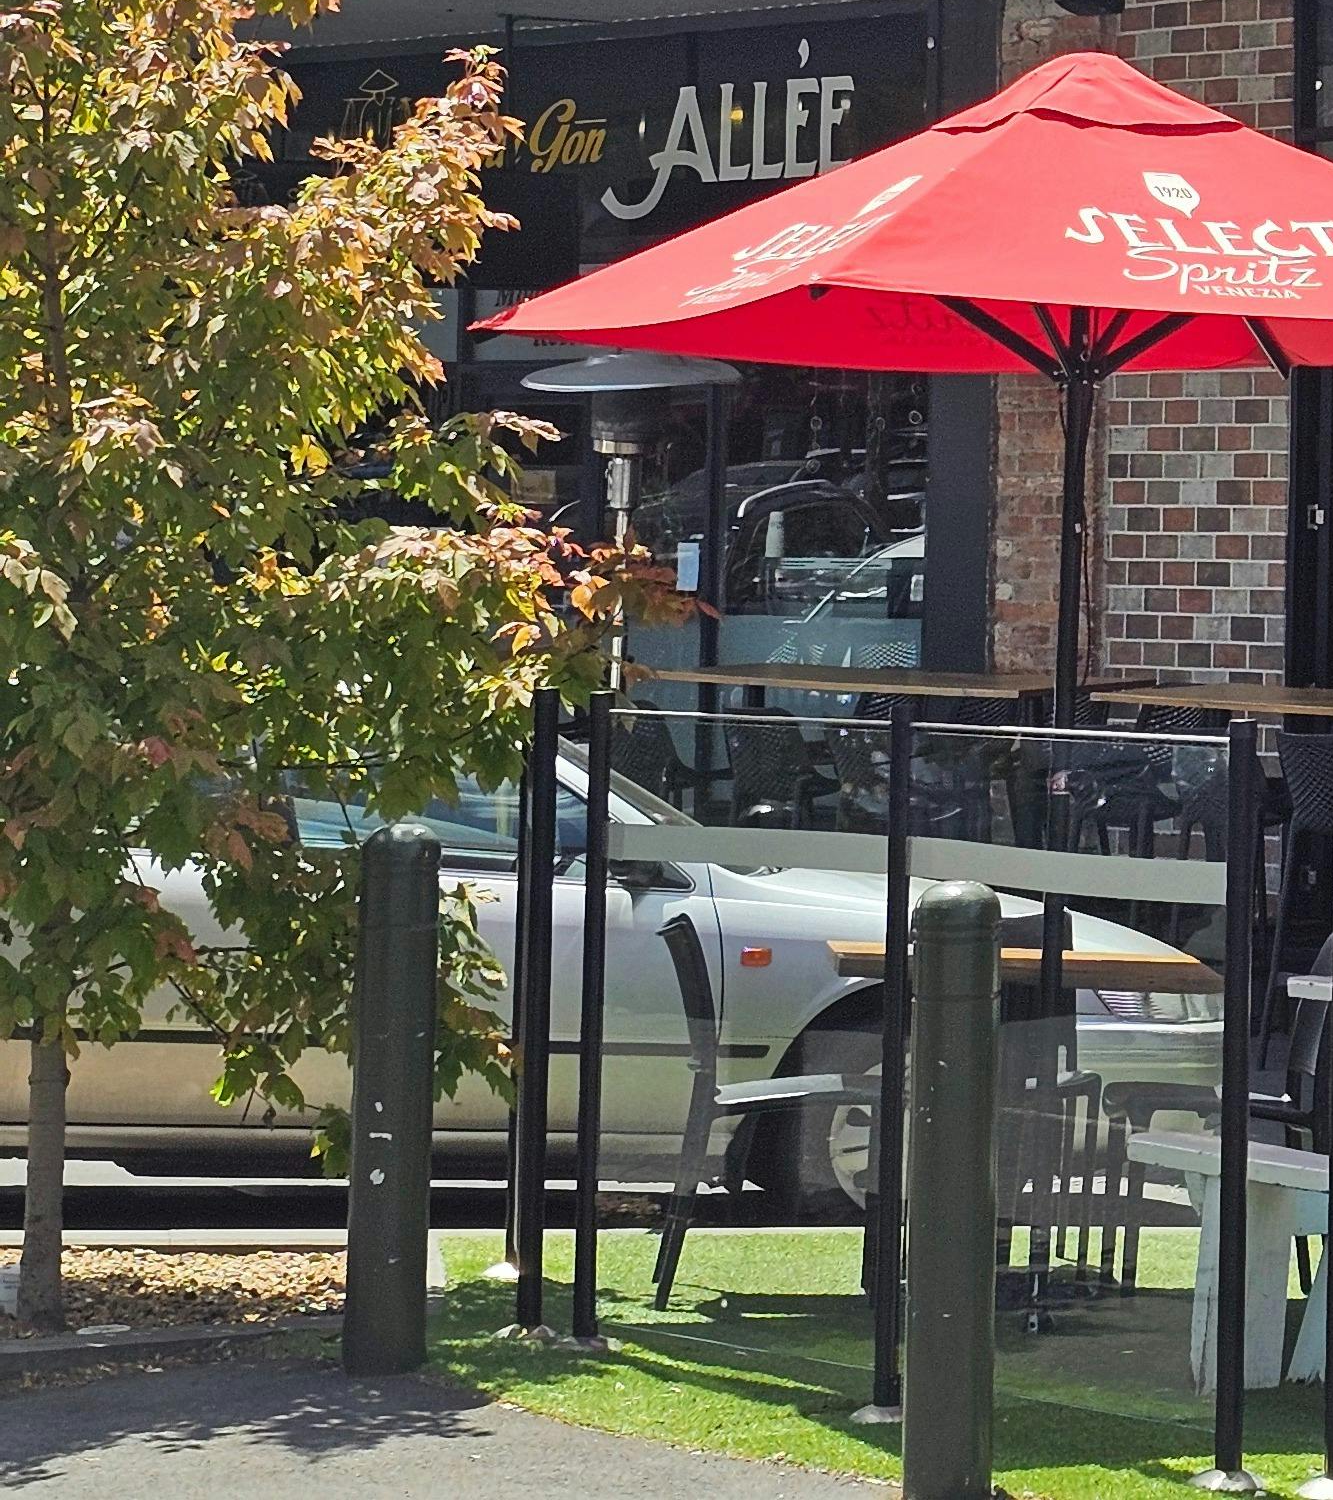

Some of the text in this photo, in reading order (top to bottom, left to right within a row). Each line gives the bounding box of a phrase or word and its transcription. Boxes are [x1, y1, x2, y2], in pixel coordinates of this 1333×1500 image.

[1153, 185, 1193, 200] 1920
[1122, 246, 1324, 295] Spritz
[1191, 284, 1303, 299] VENEZIA
